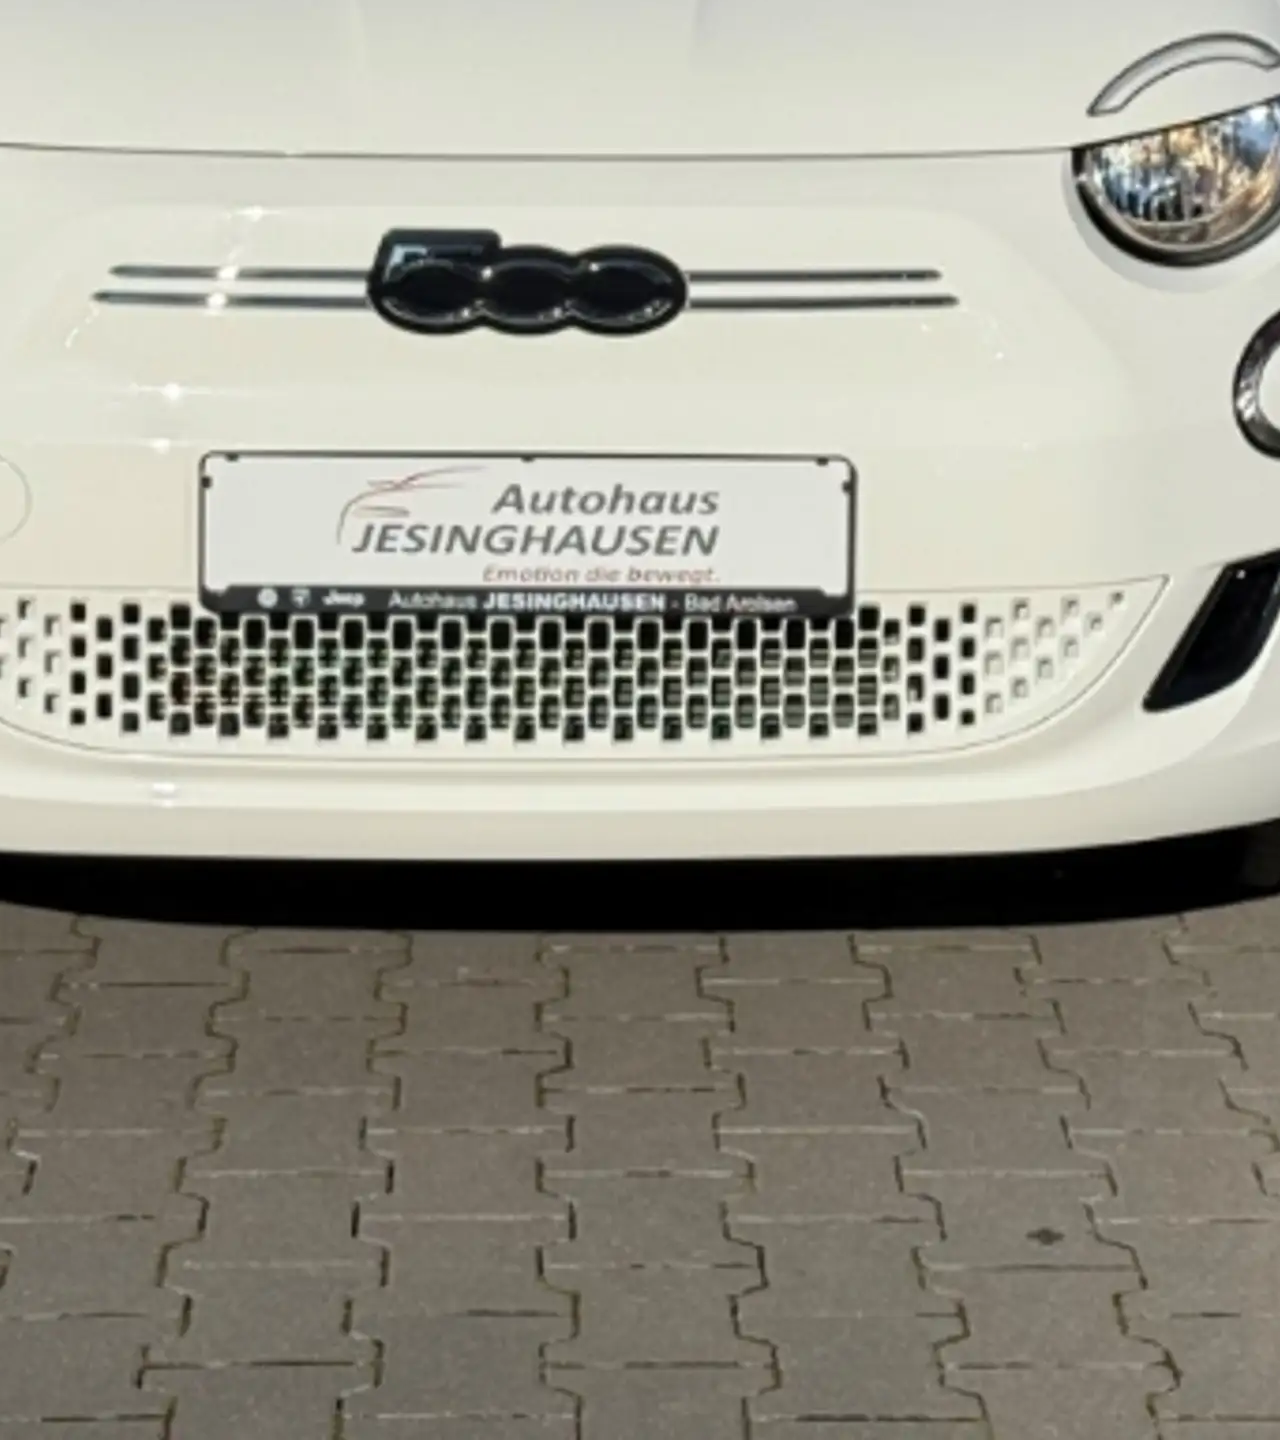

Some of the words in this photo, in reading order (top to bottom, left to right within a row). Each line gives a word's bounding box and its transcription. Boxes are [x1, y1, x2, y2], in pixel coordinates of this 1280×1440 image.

[492, 483, 720, 517] Autohaus
[352, 523, 720, 557] JESINGHAUSEN
[482, 564, 578, 584] Emotion
[585, 564, 622, 583] die
[387, 590, 478, 610] Autohaus
[483, 592, 666, 611] JESINGHAUSEN
[684, 593, 720, 611] Bad
